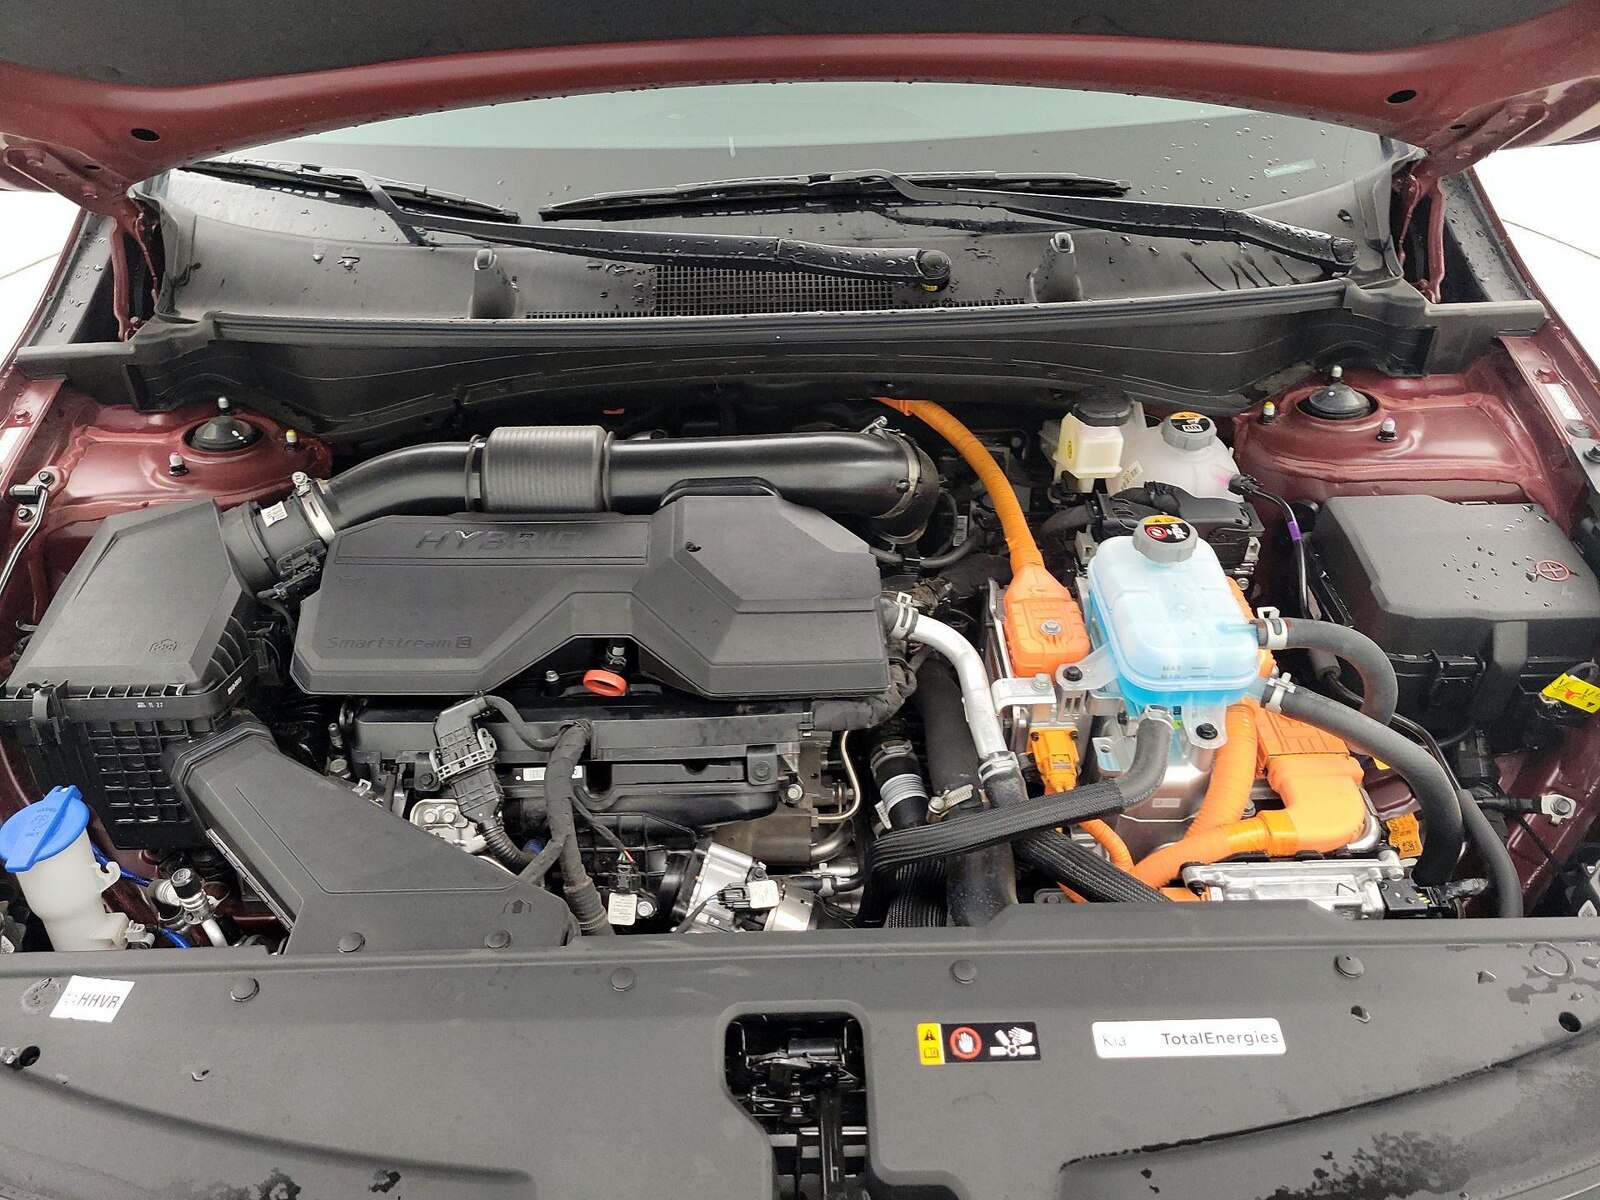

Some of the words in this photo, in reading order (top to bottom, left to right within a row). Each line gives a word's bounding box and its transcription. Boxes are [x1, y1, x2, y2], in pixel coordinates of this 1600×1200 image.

[416, 530, 583, 551] HYBRID
[327, 635, 452, 650] Smartstream
[1161, 1031, 1279, 1046] TotalEnergies
